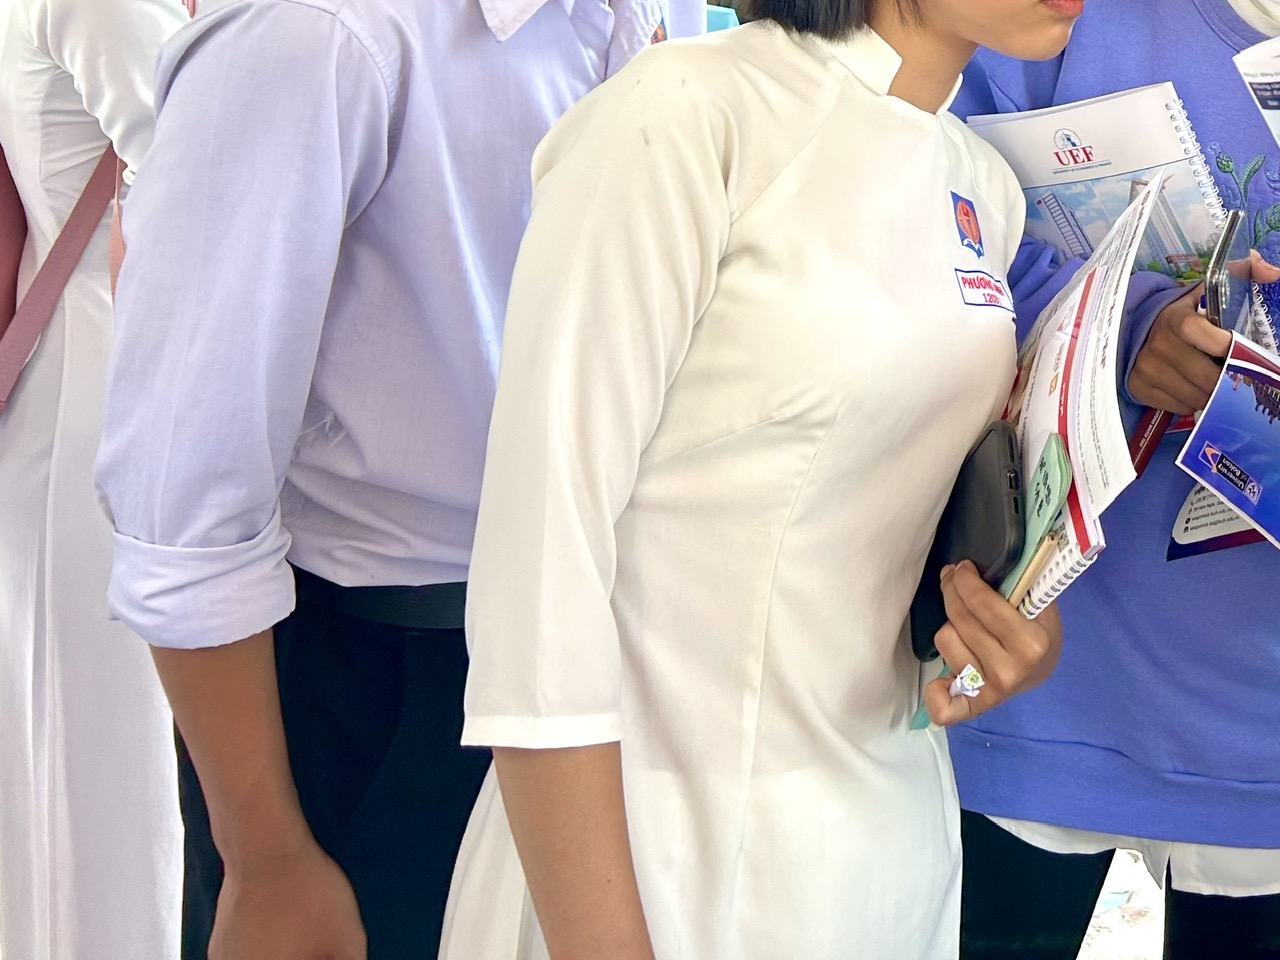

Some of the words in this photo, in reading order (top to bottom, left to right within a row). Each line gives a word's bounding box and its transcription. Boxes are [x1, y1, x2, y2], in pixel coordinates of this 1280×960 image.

[1054, 146, 1093, 166] UEF
[1217, 463, 1246, 490] University
[1222, 458, 1241, 476] Bolton
